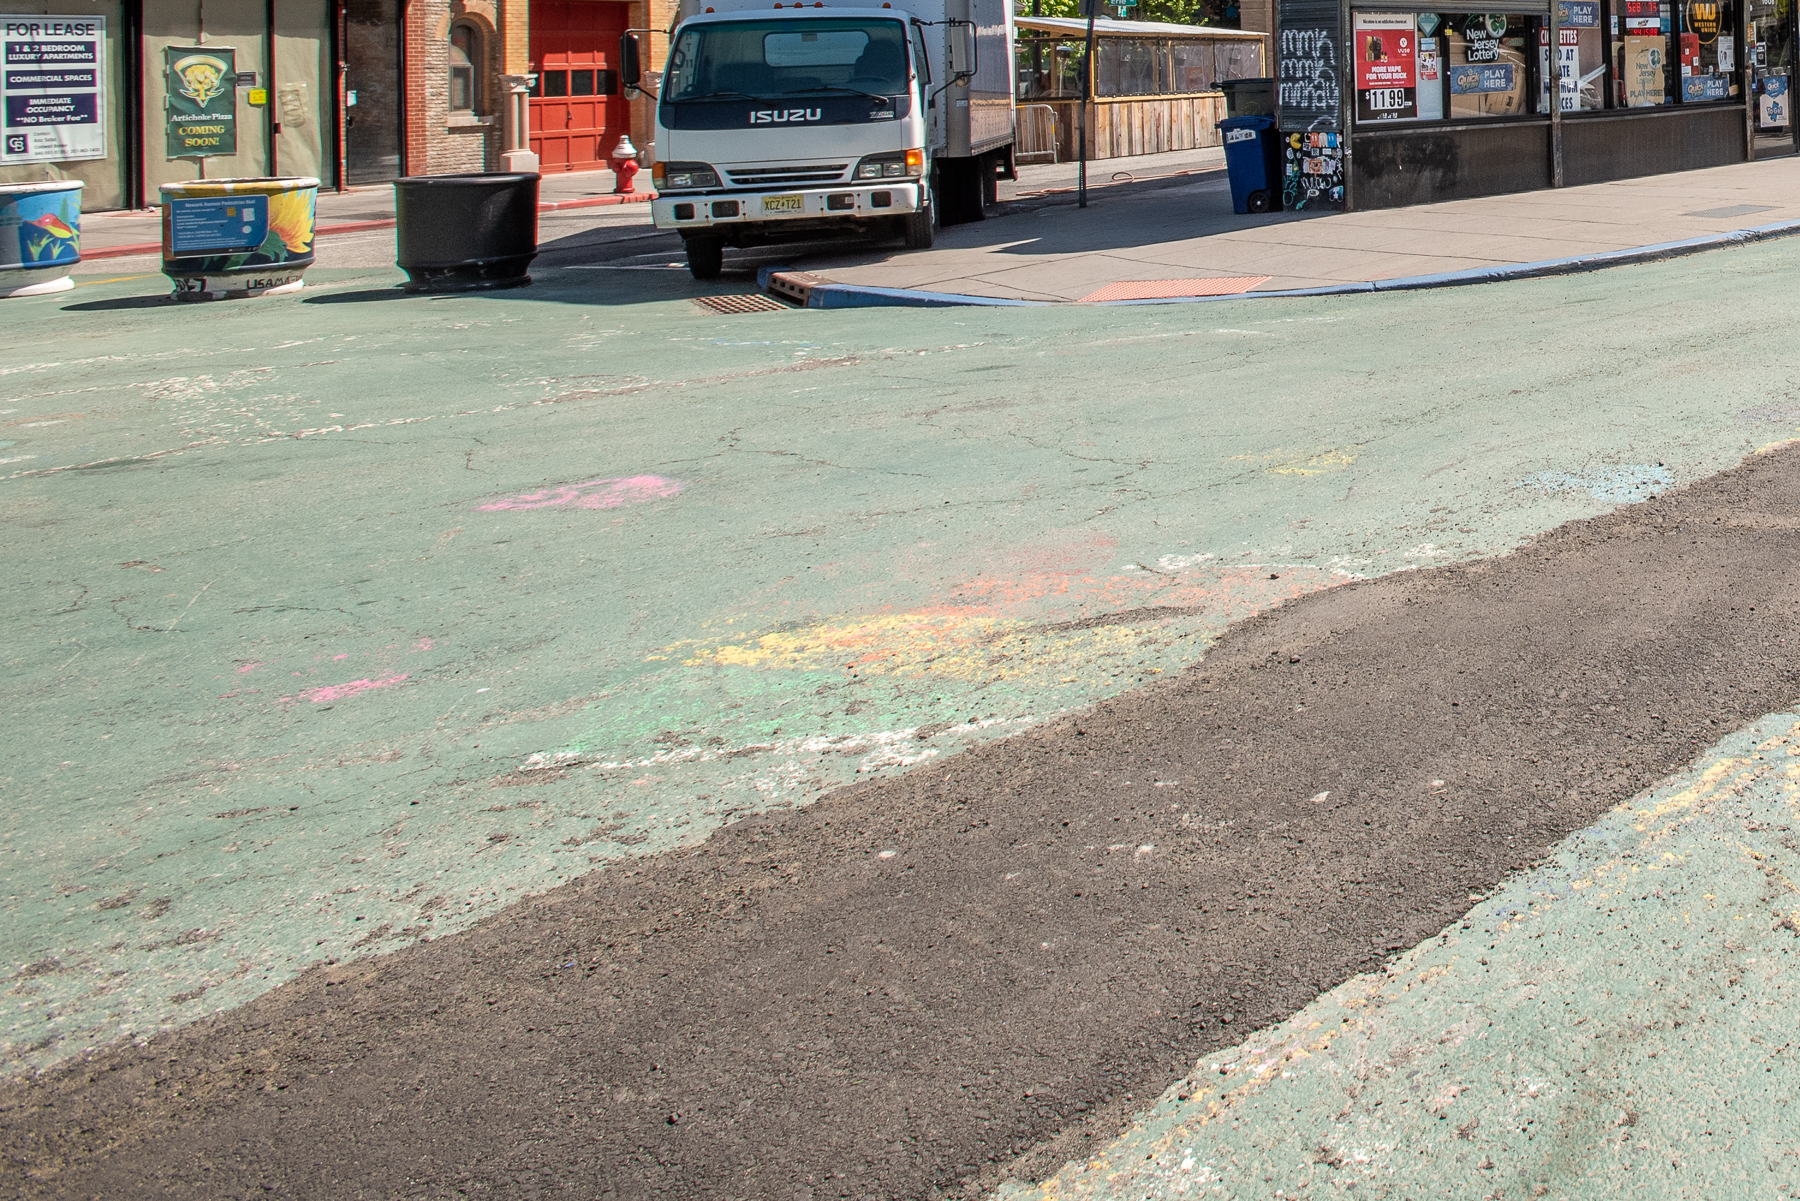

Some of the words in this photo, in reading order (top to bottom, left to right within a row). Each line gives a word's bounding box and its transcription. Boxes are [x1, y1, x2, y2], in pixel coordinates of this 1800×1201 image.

[1573, 6, 1592, 14] PLAY
[1694, 4, 1716, 20] WU
[1573, 15, 1592, 24] HERE
[6, 23, 40, 36] FOR
[44, 23, 95, 36] LEASE
[1466, 28, 1486, 40] New
[1540, 30, 1578, 44] CIETTES
[42, 44, 85, 52] BEDROOM
[1472, 38, 1499, 50] Jersey
[1468, 50, 1499, 62] Lottery
[1566, 48, 1574, 60] AT
[64, 74, 92, 82] SPACES
[1378, 72, 1392, 80] YOUR
[1484, 70, 1506, 78] PLAY
[1639, 70, 1656, 78] Jersey
[1457, 72, 1480, 86] Quick
[1484, 78, 1506, 88] HERE
[1688, 83, 1704, 92] Quick
[1706, 80, 1722, 88] PLAY
[1630, 90, 1644, 98] PLAY
[1706, 88, 1724, 96] HERE
[29, 98, 72, 106] IMMEDIATE
[26, 106, 75, 114] OCCUPANCY
[171, 114, 212, 122] Artichoke
[750, 108, 822, 124] ISUZU
[178, 126, 225, 136] COMING
[184, 138, 220, 146] SOON!
